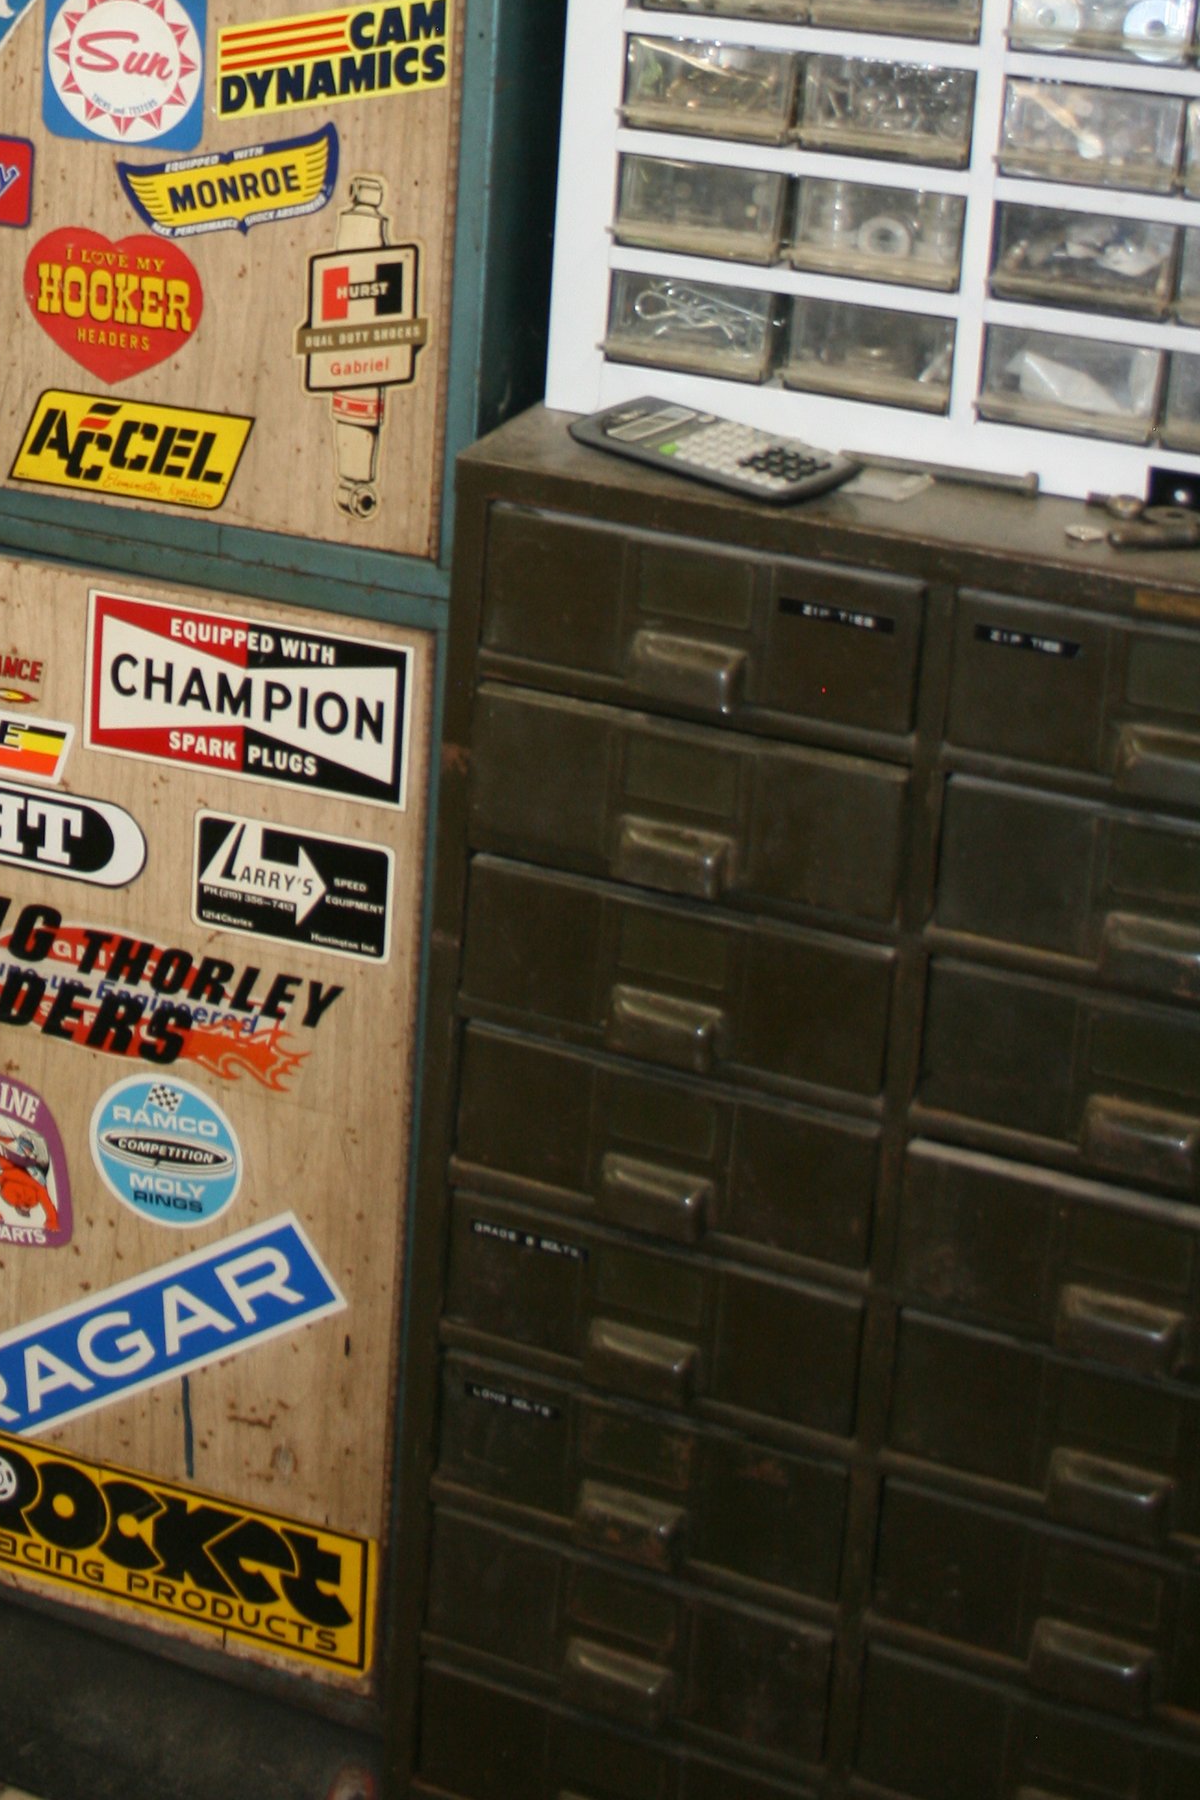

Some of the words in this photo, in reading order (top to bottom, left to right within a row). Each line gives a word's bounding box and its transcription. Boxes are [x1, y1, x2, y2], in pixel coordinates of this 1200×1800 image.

[75, 30, 173, 81] Sun
[221, 44, 446, 115] DYNAMICS
[164, 154, 220, 173] EQUIPPED
[233, 146, 264, 161] WITH
[168, 163, 301, 213] MONROE
[174, 219, 239, 236] PERFORMANCE
[245, 210, 274, 227] SHOCK
[66, 248, 72, 260] I
[81, 250, 129, 269] LOVE
[136, 257, 165, 272] MY
[37, 263, 192, 332] HOOKER
[336, 282, 389, 300] HURST
[77, 328, 150, 351] HEADERS
[305, 332, 336, 348] DUAL
[339, 329, 370, 345] DUTY
[373, 326, 421, 342] SHOCKS
[330, 357, 390, 377] Gabriel
[27, 406, 224, 484] ACCEL
[170, 618, 274, 654] EQUIPPED
[280, 636, 335, 665] WITH
[110, 653, 385, 745] CHAMPION
[168, 730, 238, 761] SPARK
[247, 745, 317, 776] PLUGS
[220, 822, 314, 896] LARRY'S
[333, 877, 367, 893] SPEED
[325, 894, 384, 915] EQUIPMENT
[310, 931, 359, 952] Huntington
[361, 940, 377, 954] Ind.
[76, 930, 345, 1029] THORLEY
[112, 1104, 219, 1138] RAMCO
[117, 1136, 215, 1164] COMPETITION
[128, 1173, 207, 1201] MOLY
[133, 1189, 203, 1213] RINGS
[126, 1571, 339, 1654] PRODUCTS
